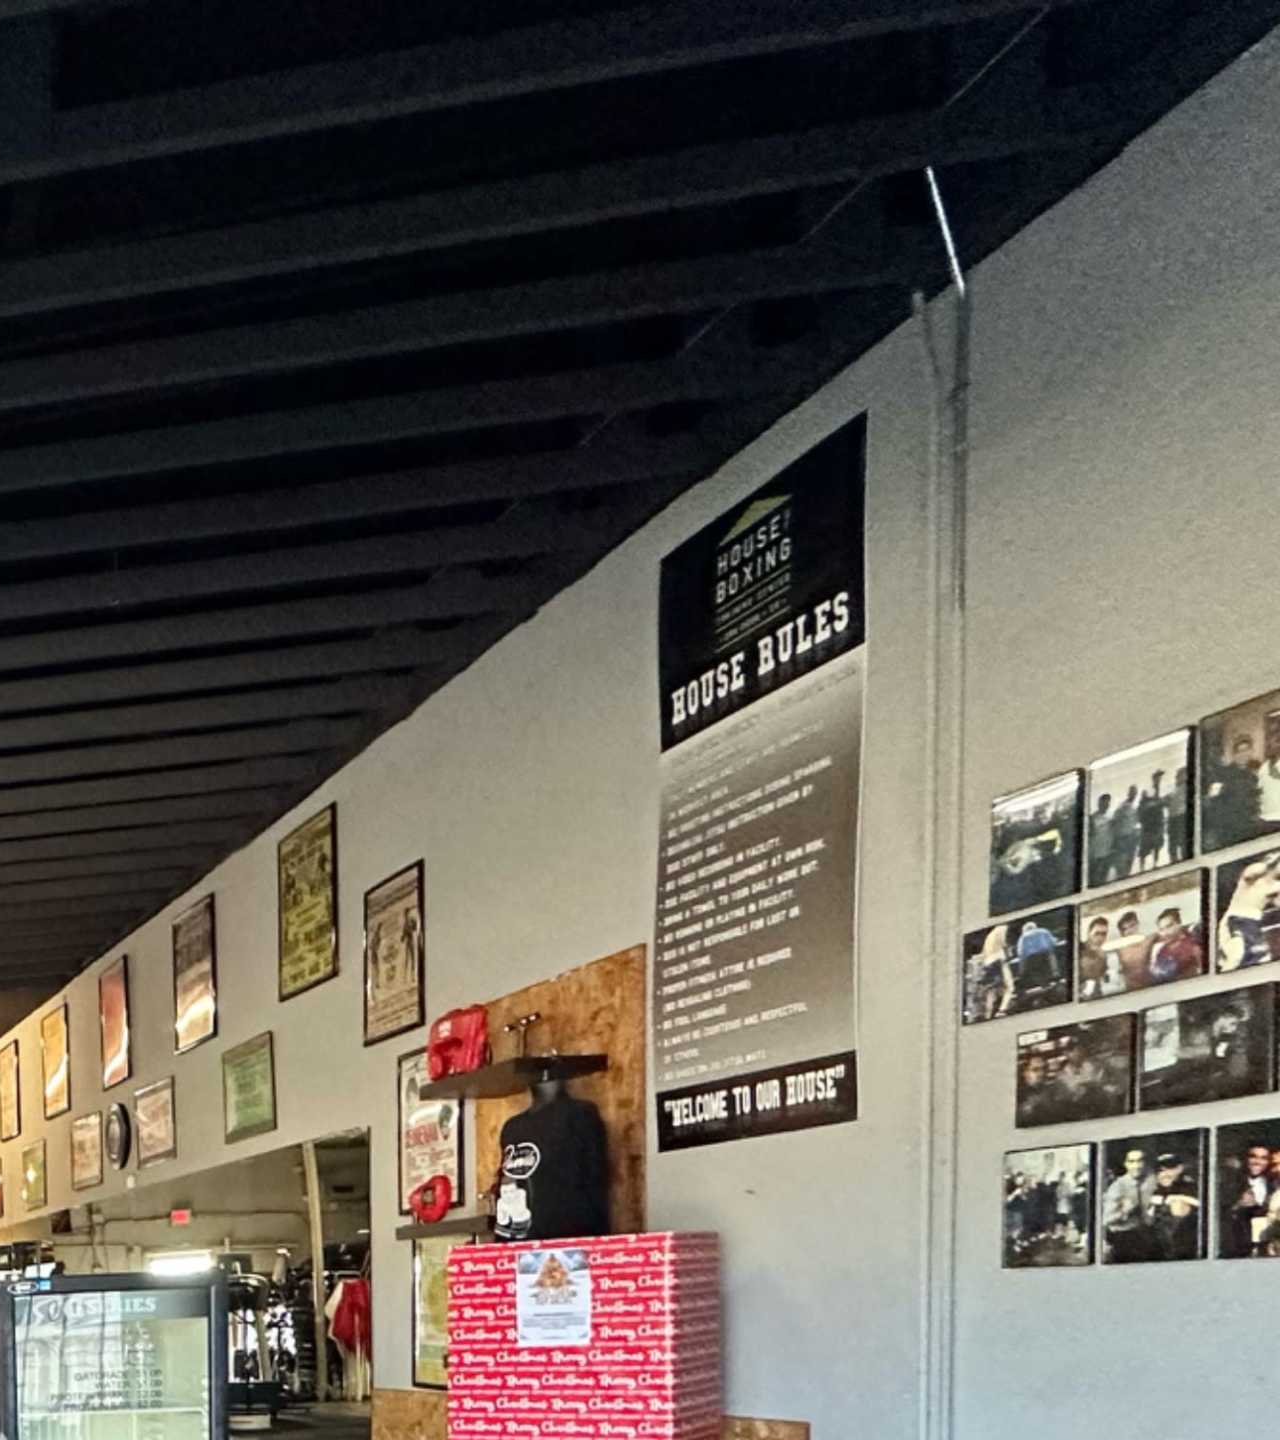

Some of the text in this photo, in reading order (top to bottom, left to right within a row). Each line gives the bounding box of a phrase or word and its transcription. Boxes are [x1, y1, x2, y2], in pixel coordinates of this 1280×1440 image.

[716, 516, 780, 574] HOUSE
[716, 537, 793, 605] BOXING
[671, 651, 746, 725] HOUSE
[758, 591, 851, 677] RULES
[732, 1086, 751, 1115] TO
[755, 1079, 780, 1112] OUR
